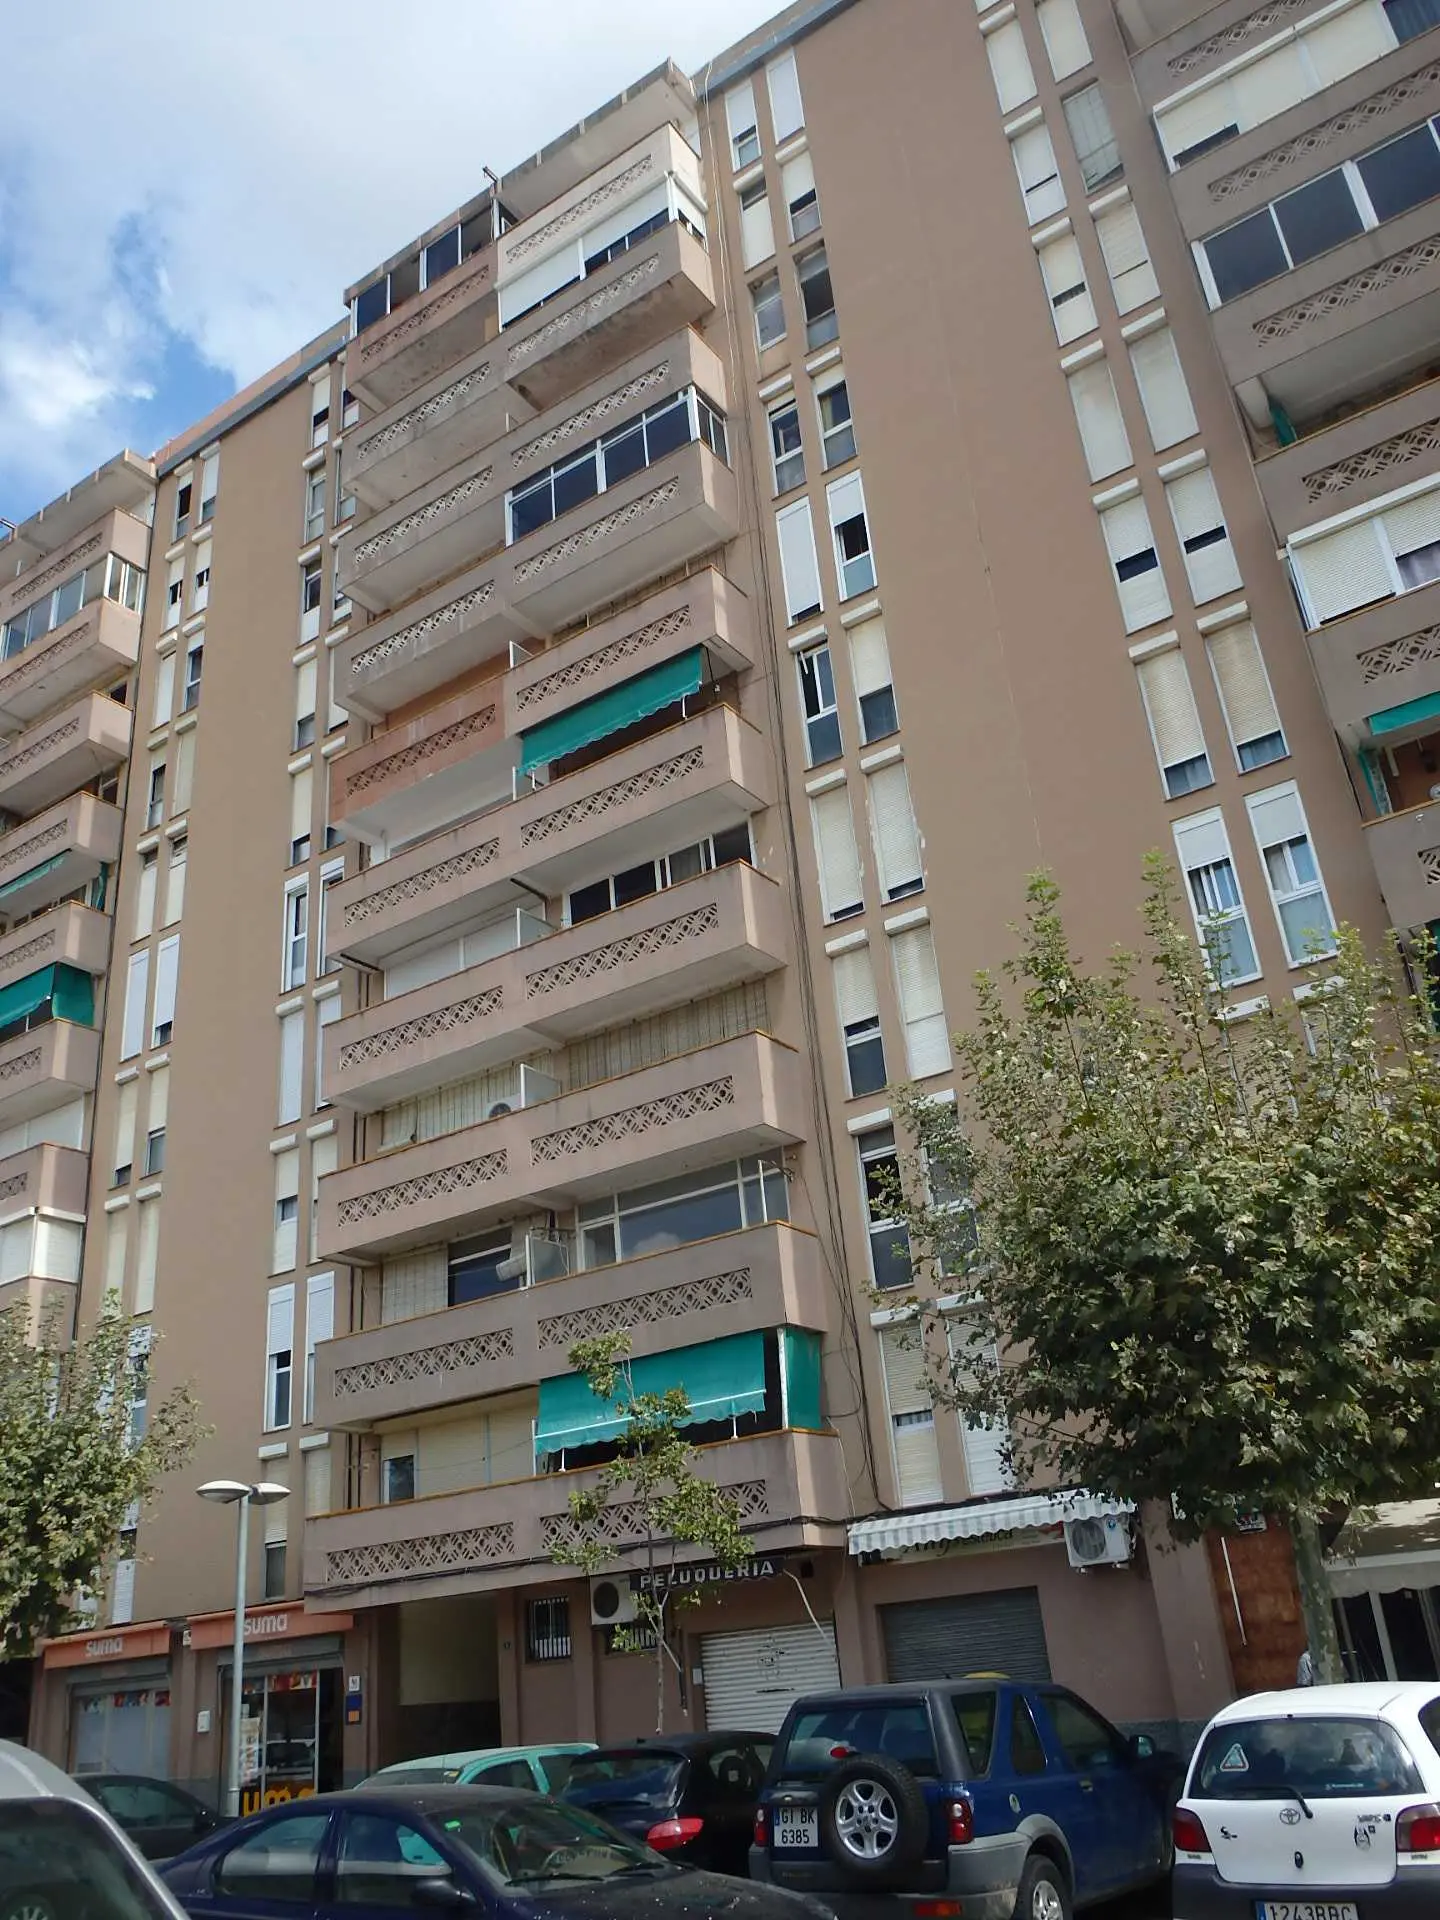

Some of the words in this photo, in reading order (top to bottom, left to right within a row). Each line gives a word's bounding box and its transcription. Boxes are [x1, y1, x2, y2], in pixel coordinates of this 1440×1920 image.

[243, 1614, 287, 1636] suma
[86, 1637, 123, 1656] suma
[781, 1829, 809, 1844] 6385
